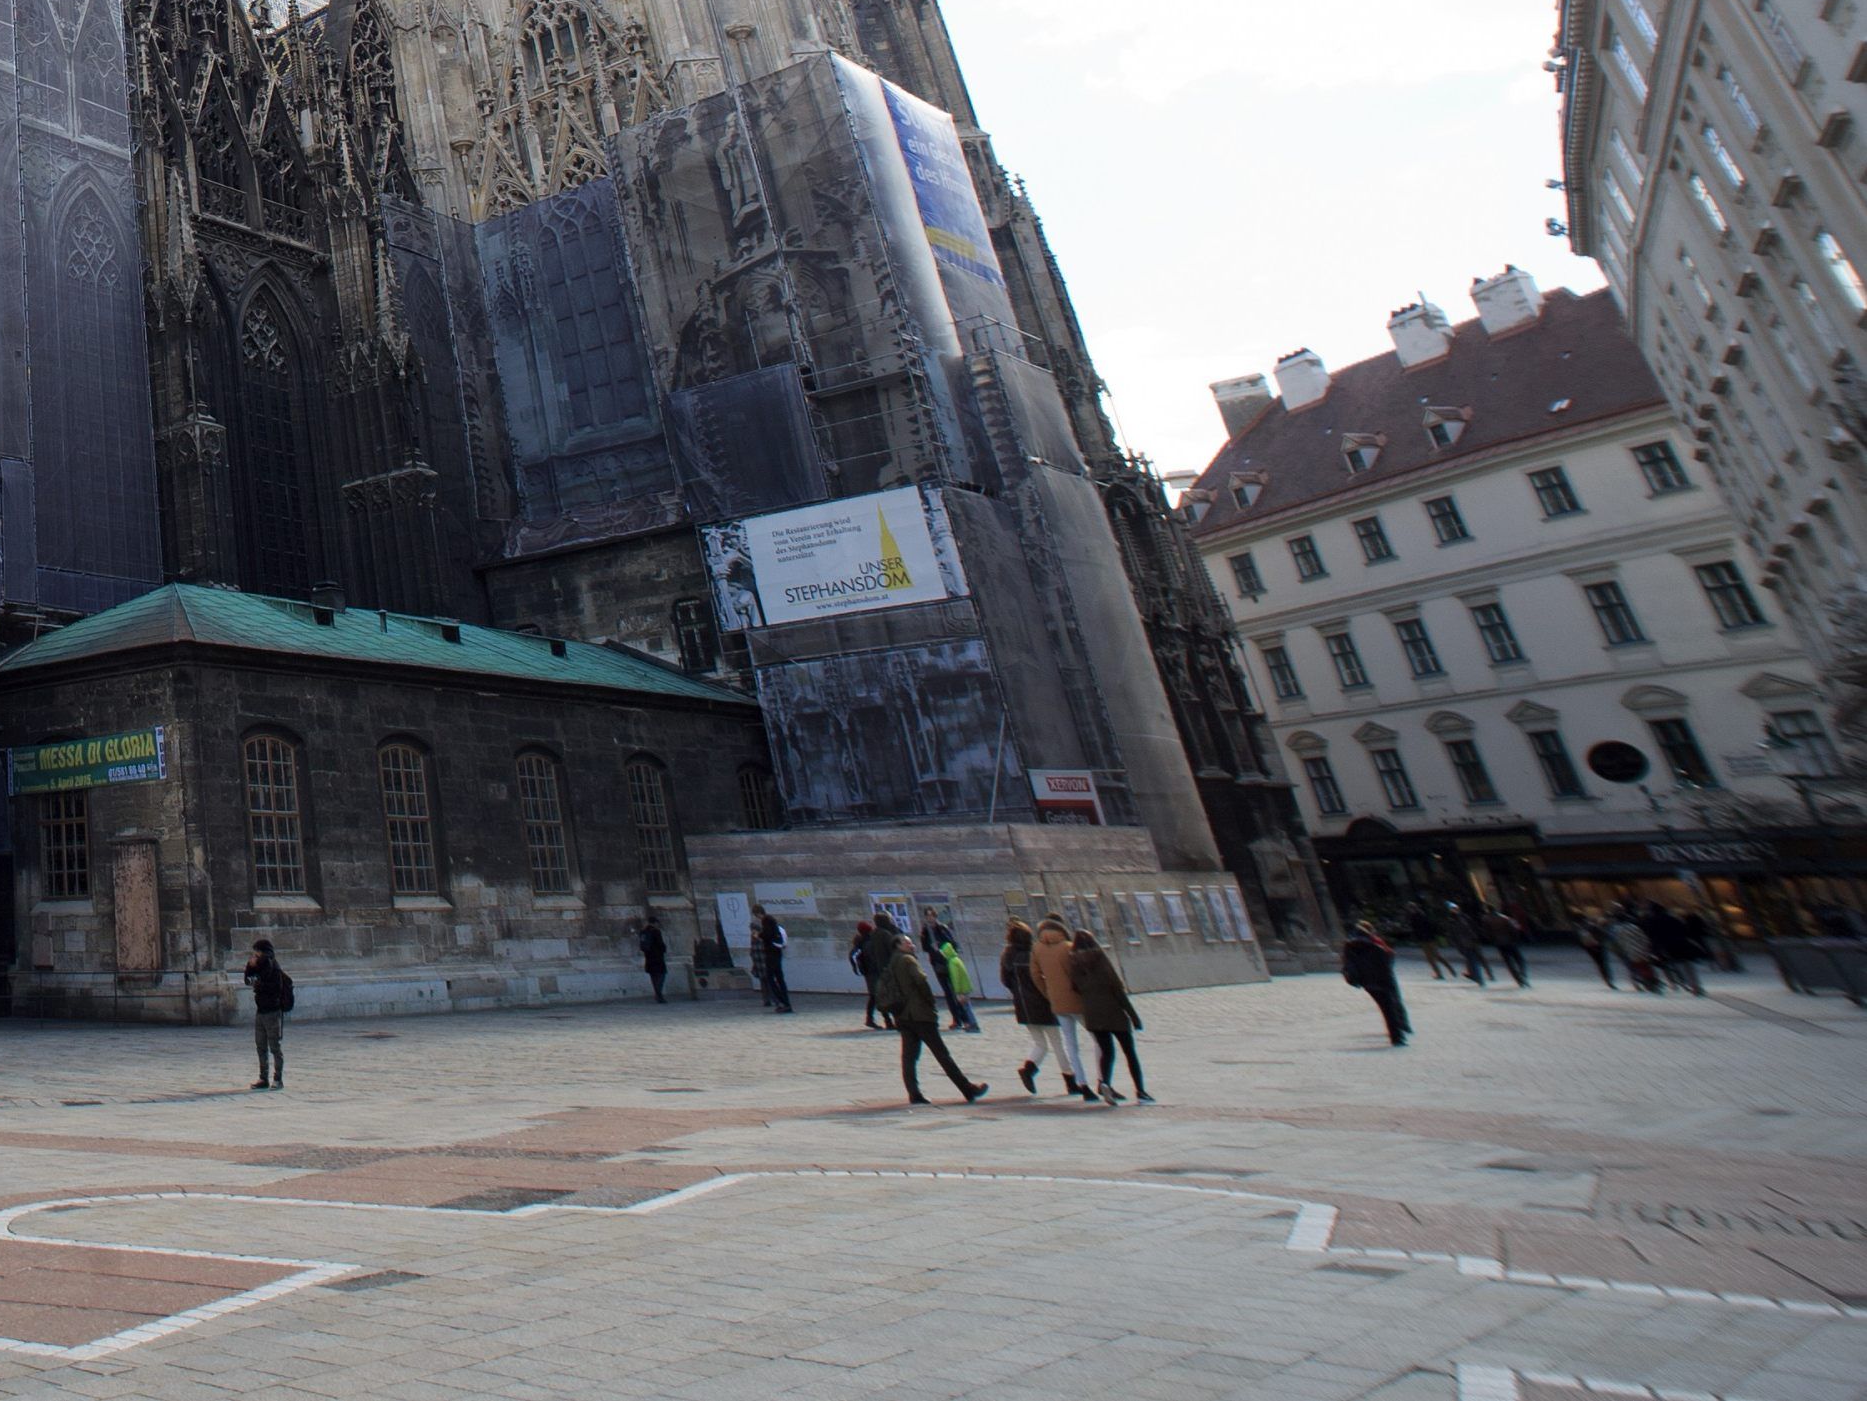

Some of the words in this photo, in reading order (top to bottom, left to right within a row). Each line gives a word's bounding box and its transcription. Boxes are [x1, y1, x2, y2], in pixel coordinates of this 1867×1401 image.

[915, 162, 940, 186] des
[834, 516, 851, 527] wird
[775, 546, 787, 555] des
[859, 557, 904, 574] UNSER
[785, 572, 912, 604] STEPHANSDOM
[39, 744, 84, 770] MESSA
[88, 741, 101, 764] DI
[105, 733, 155, 762] GLORIA
